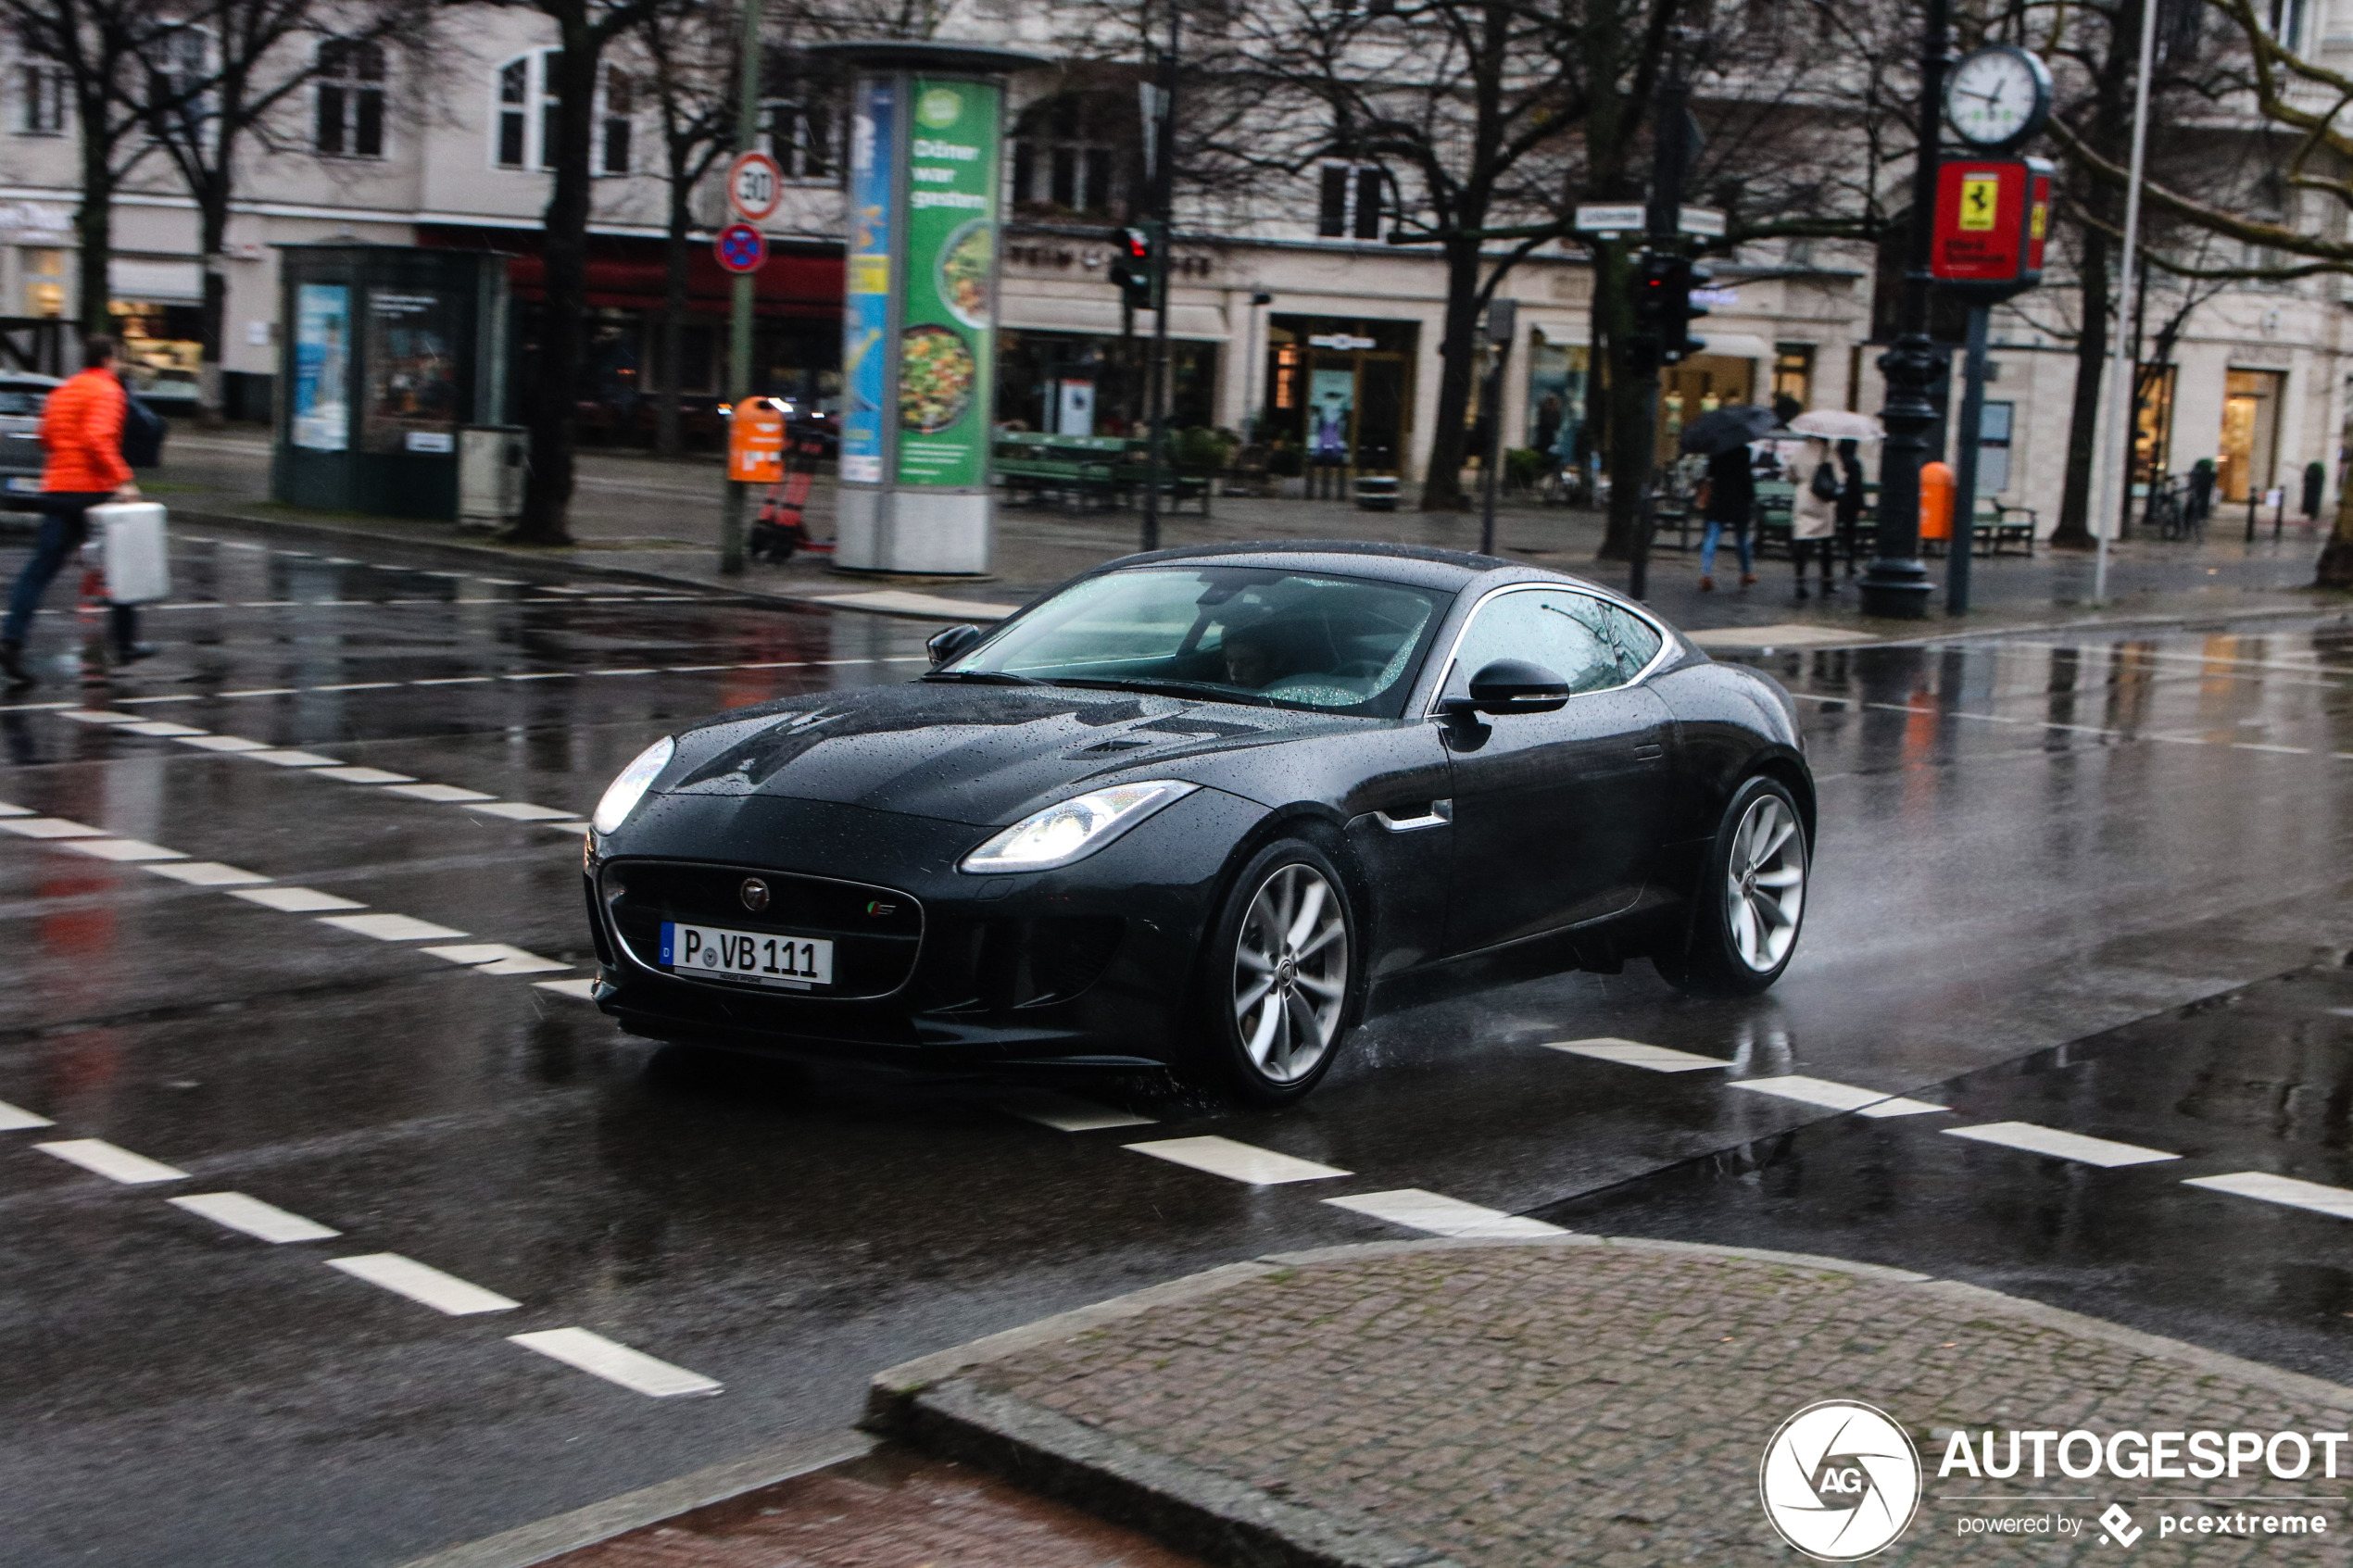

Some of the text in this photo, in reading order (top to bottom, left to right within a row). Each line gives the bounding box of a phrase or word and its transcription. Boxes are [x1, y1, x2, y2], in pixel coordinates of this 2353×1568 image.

[912, 140, 980, 160] Döner
[912, 168, 956, 182] war
[738, 171, 772, 201] 30
[911, 190, 987, 208] gestern
[1402, 818, 1431, 827] JAGUAR
[662, 947, 670, 958] D
[685, 929, 818, 978] P VB 111
